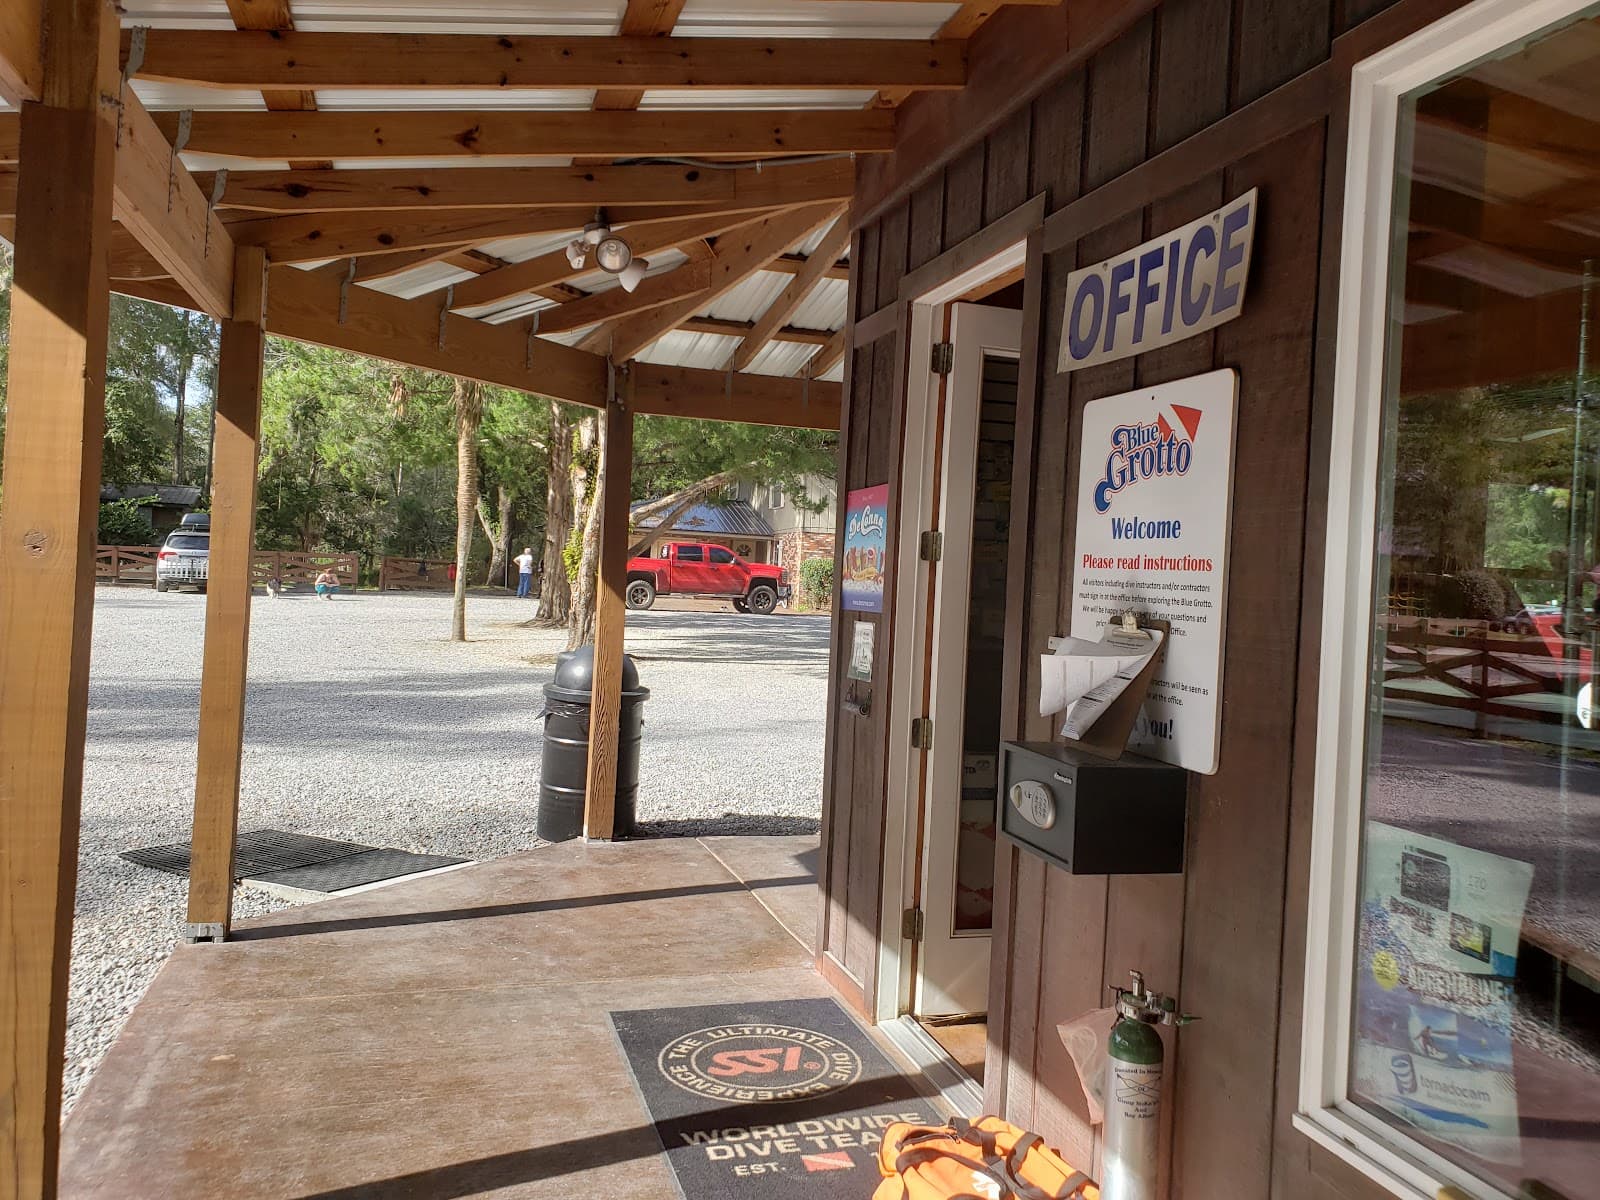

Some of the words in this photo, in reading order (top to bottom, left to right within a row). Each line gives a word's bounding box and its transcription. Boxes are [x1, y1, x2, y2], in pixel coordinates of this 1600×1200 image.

[1069, 202, 1250, 361] OFFICE
[1112, 422, 1159, 451] Blue
[1094, 432, 1192, 512] Grotto
[1111, 516, 1181, 540] Welcome
[1083, 553, 1114, 570] Please
[1117, 554, 1141, 571] read
[1143, 554, 1213, 572] instructions
[1089, 578, 1104, 587] visitors
[1104, 579, 1125, 589] including
[1136, 580, 1161, 590] instructors
[1162, 581, 1180, 591] and/or
[1180, 583, 1210, 592] contractors
[1109, 593, 1117, 601] the
[1117, 593, 1131, 602] office
[1131, 594, 1147, 603] before
[1147, 596, 1171, 606] exploring
[1171, 597, 1180, 606] the
[1181, 598, 1193, 607] Blue
[1193, 599, 1213, 608] Grotto.
[1082, 604, 1090, 612] We
[1098, 606, 1105, 614] be
[1105, 606, 1119, 616] happy
[1158, 613, 1170, 621] your
[1170, 613, 1195, 623] questions
[1196, 615, 1207, 623] and
[1170, 627, 1187, 637] Office.
[1158, 692, 1167, 701] the
[1167, 695, 1184, 706] office.
[1171, 681, 1181, 690] will
[1181, 683, 1188, 692] be
[1188, 684, 1202, 694] seen
[1202, 687, 1209, 696] as
[668, 1038, 703, 1060] THE
[707, 1026, 836, 1050] ULTIMATE
[707, 1046, 802, 1077] SSI
[828, 1052, 852, 1082] DIVE
[670, 1063, 831, 1100] EXPERIENCE
[681, 1112, 927, 1146] WORLDWIDE
[706, 1137, 802, 1161] DIVE
[806, 1130, 884, 1150] TEA
[733, 1162, 787, 1177] EST.
